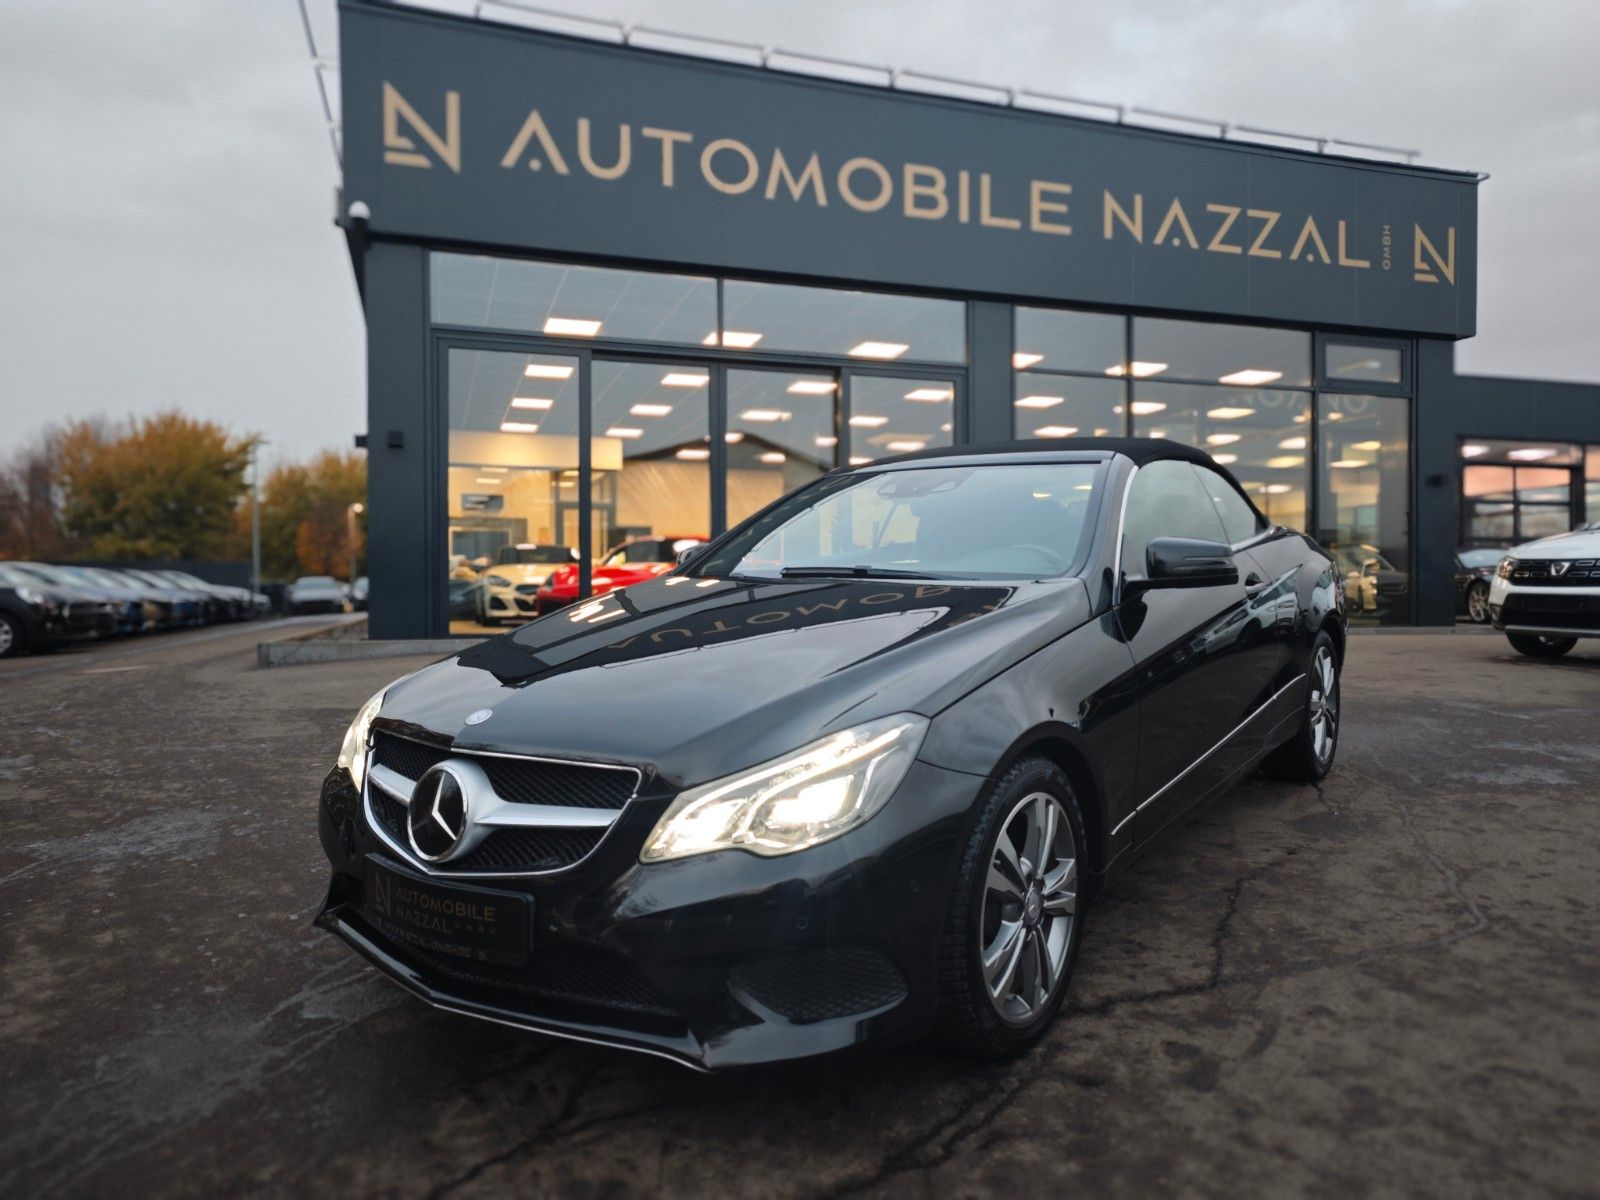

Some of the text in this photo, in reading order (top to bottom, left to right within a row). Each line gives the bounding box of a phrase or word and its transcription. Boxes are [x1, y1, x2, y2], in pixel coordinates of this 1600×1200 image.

[501, 111, 1072, 235] AUTOMOBILE
[1104, 189, 1370, 268] NAZZAL
[1383, 224, 1391, 270] GMBH
[395, 905, 452, 935] NAZZAL
[396, 887, 496, 922] AUTOMOBILE
